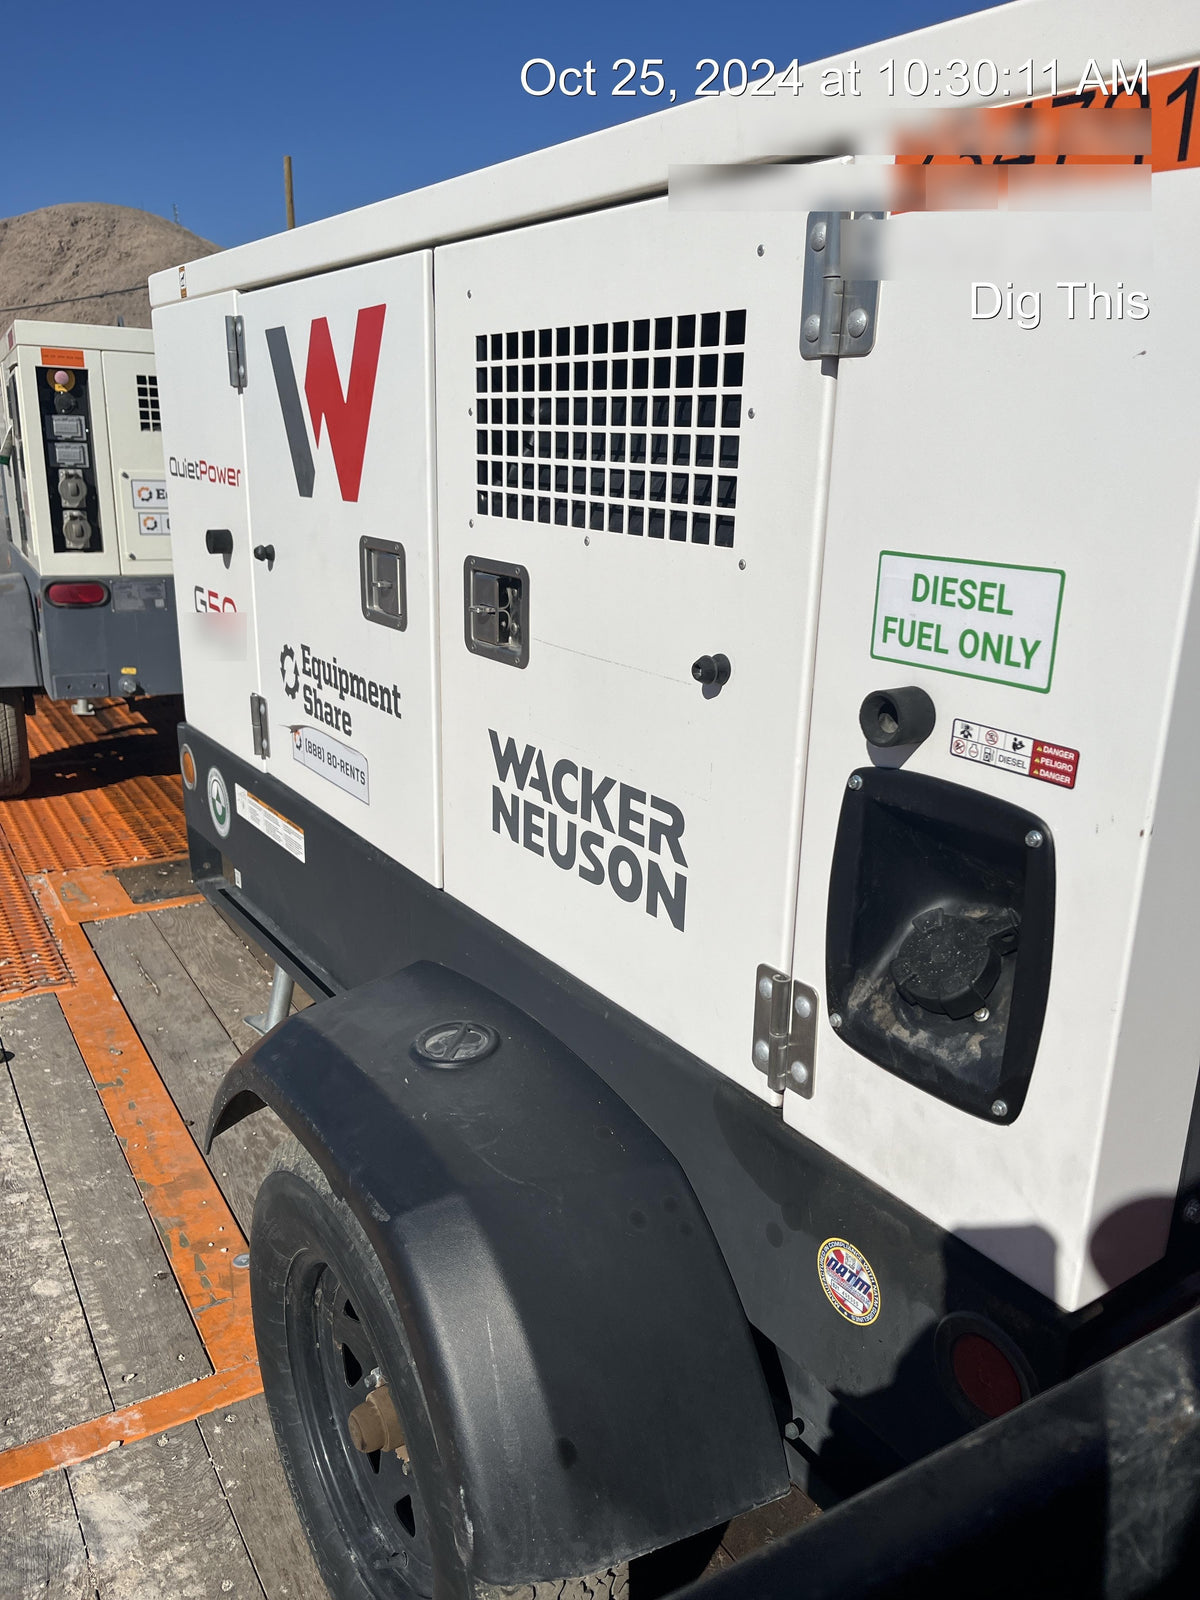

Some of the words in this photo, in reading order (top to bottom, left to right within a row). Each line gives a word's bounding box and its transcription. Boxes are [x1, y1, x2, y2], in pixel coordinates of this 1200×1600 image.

[169, 456, 241, 487] QuietPower
[912, 573, 1013, 616] DIESEL
[882, 616, 949, 654] FUEL
[958, 628, 1042, 670] ONLY
[300, 643, 402, 719] Equipment
[303, 684, 352, 737] Share
[304, 738, 325, 763] (888)
[326, 751, 366, 786] 80-RENTS
[998, 754, 1027, 770] DIESEL
[1040, 757, 1074, 772] PELIGRO
[1042, 745, 1075, 760] DANGER
[1039, 768, 1071, 784] DANGER
[488, 728, 688, 868] WACKER
[492, 784, 688, 933] NEUSON
[826, 1257, 871, 1295] NATM
